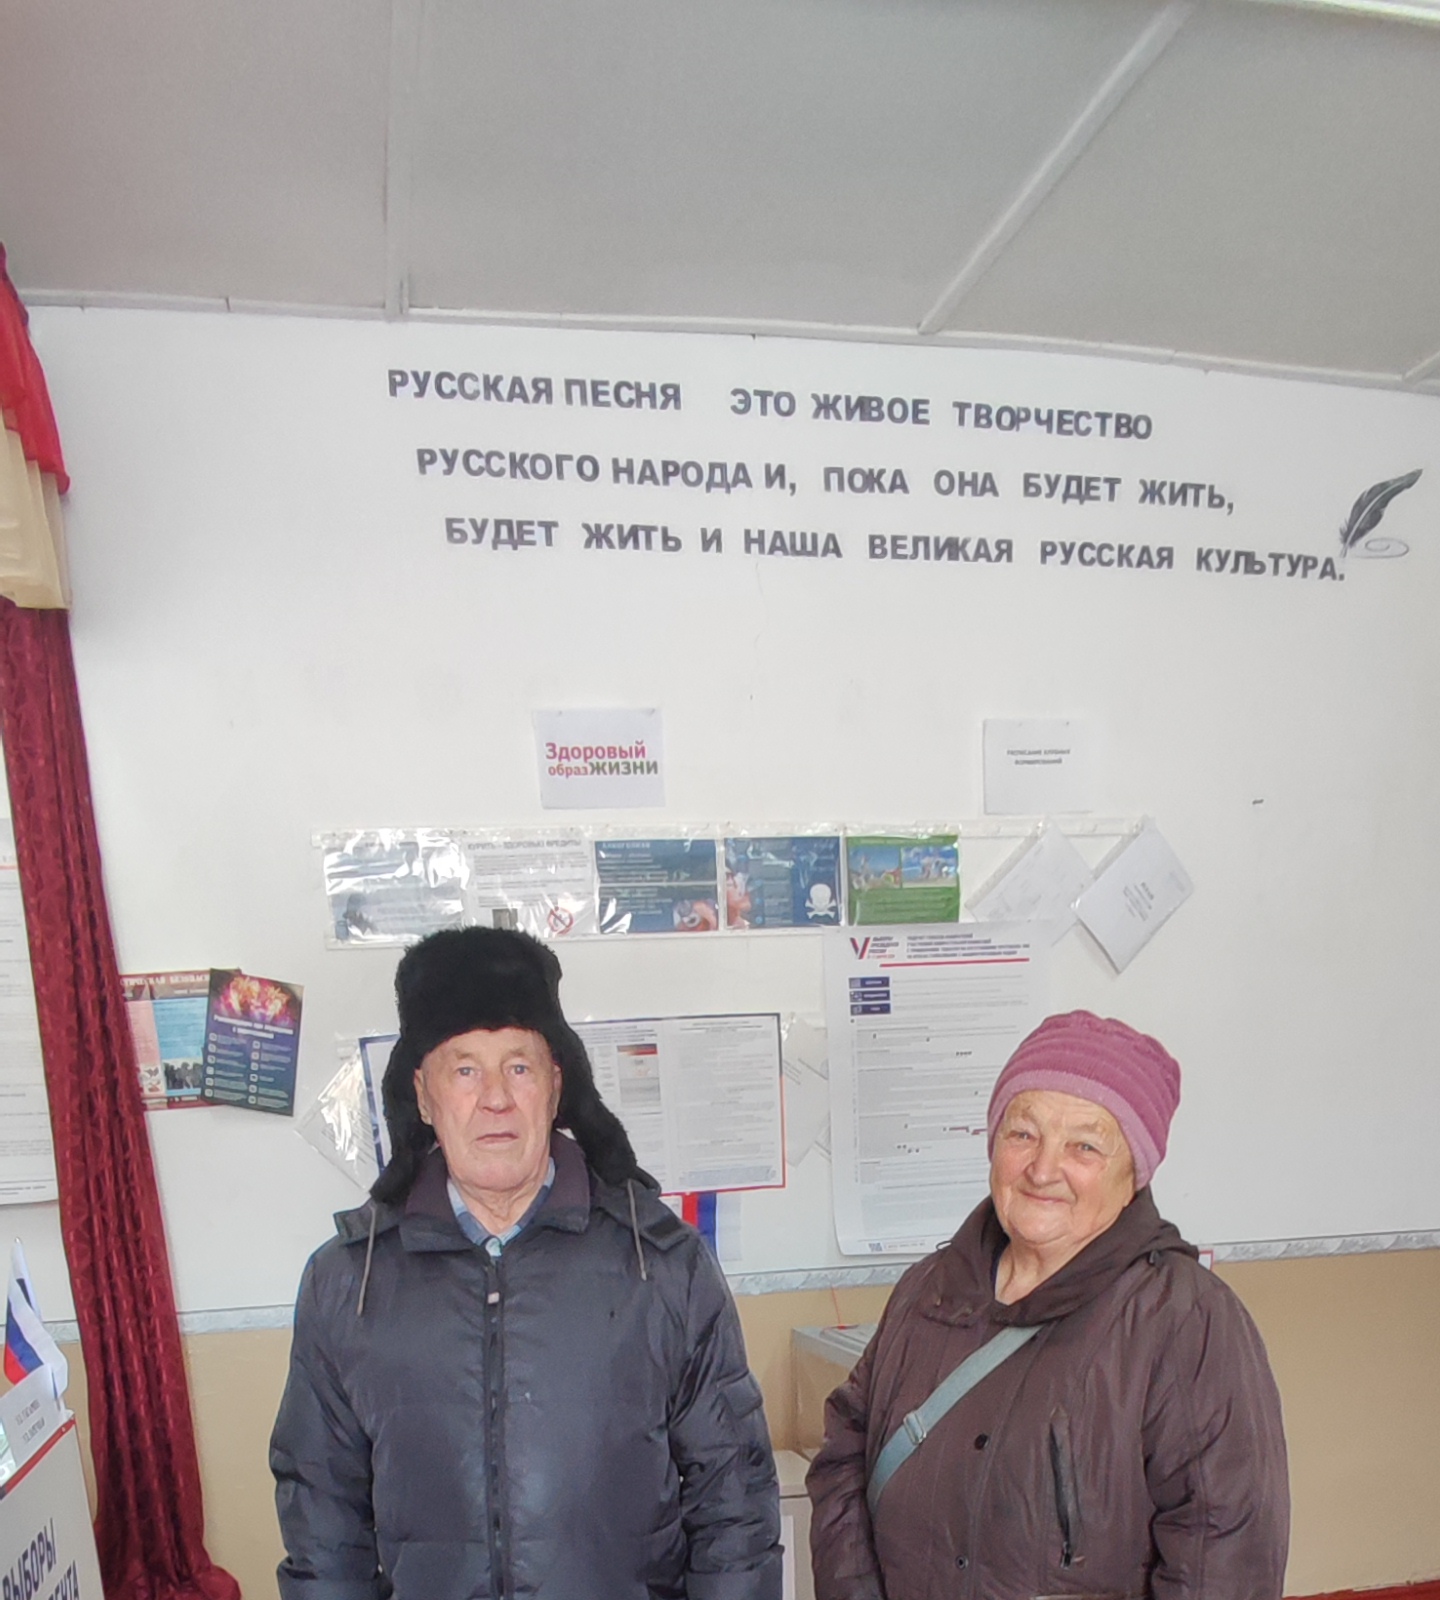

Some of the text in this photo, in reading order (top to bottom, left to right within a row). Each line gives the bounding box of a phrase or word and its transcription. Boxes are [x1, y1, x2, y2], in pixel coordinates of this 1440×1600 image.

[388, 370, 1153, 440] РУССКАЯ ПЕСНЯ ЭТО ЖИВОЕ ТВОРЧЕСТВО
[417, 448, 1236, 515] РУССКОГО НАРОДА И, ПОКА ОНА БУДЕТ ЖИТЬ,
[445, 517, 1345, 582] БУДЕТ ЖИТЬ И НАША ВЕЛИКАЯ РУССКАЯ КУЛЬТУРА.
[545, 739, 646, 763] Здоровый
[548, 763, 588, 778] образ
